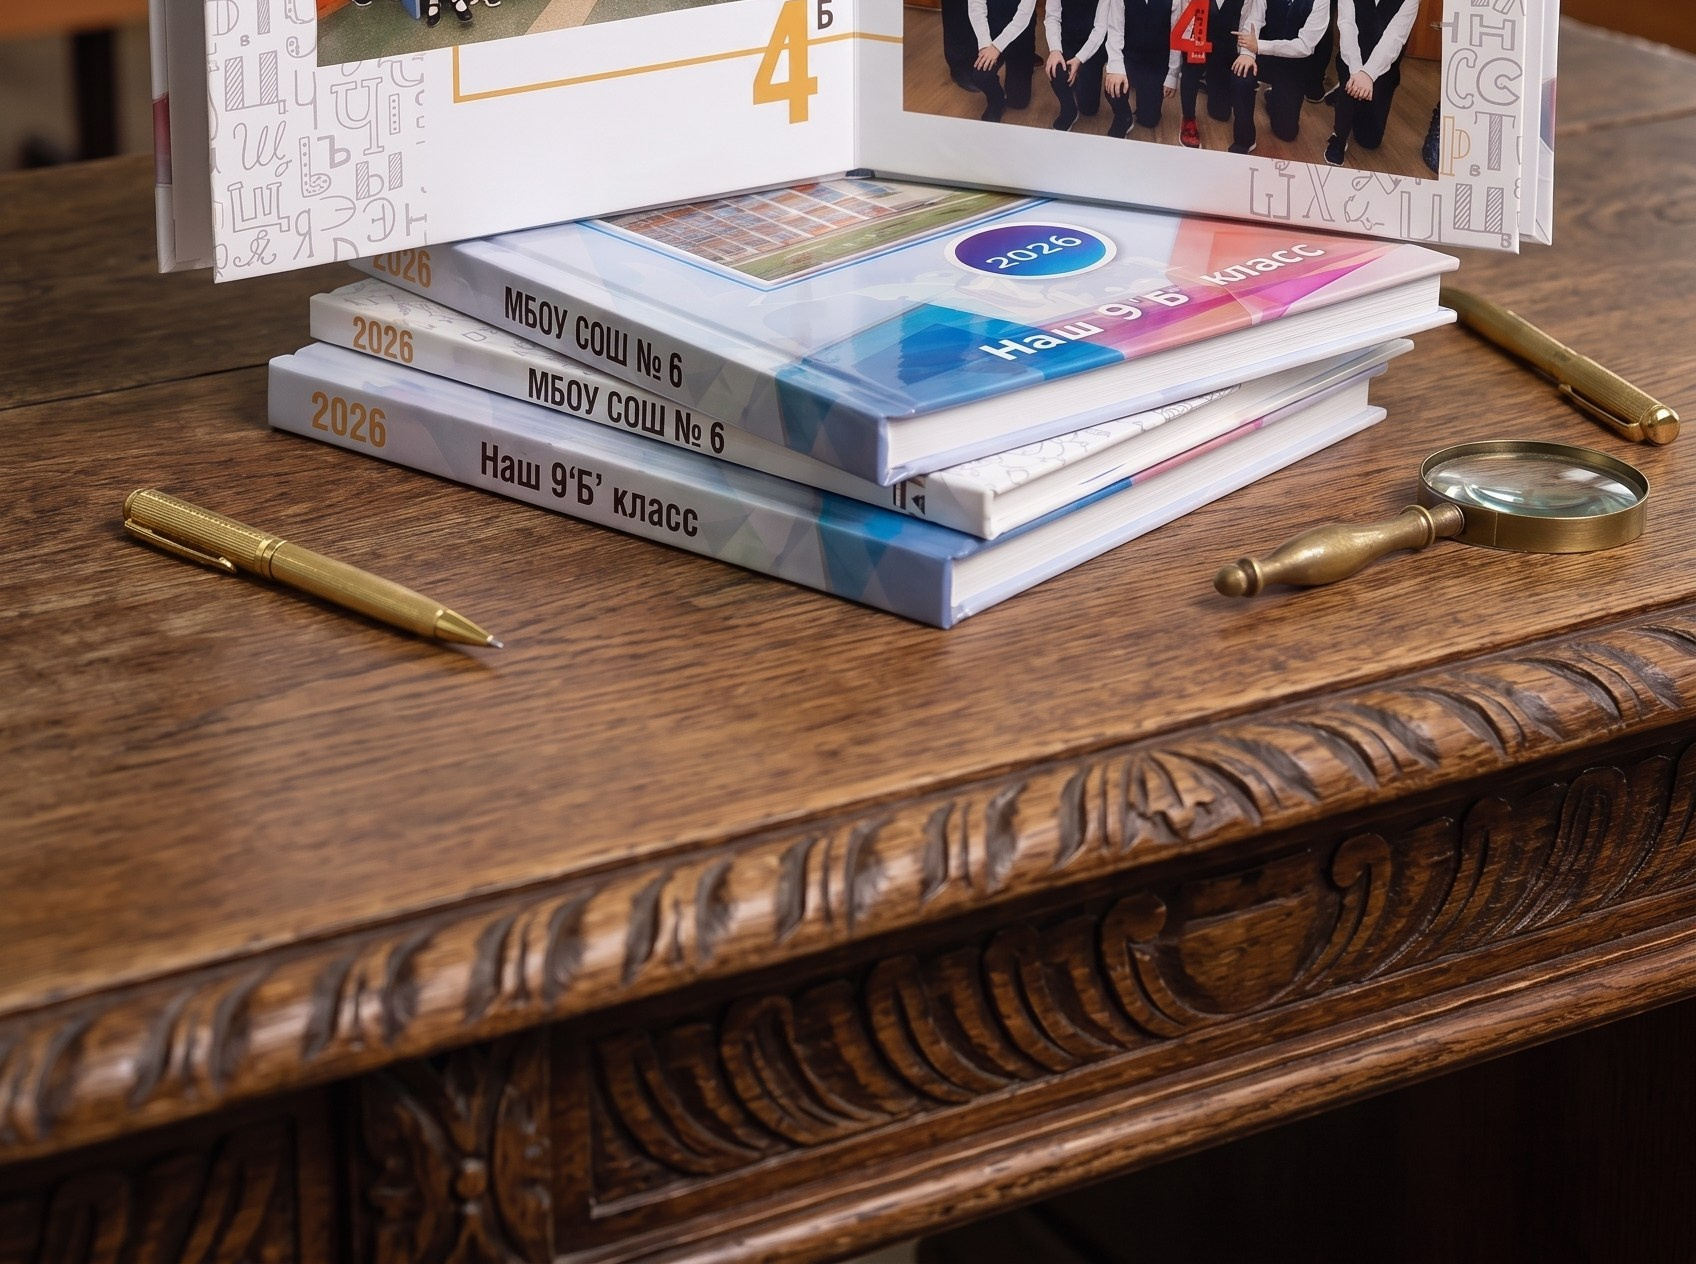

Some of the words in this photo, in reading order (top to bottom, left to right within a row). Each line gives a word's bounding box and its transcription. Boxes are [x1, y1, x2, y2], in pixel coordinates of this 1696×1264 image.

[986, 234, 1083, 270] 2026
[352, 315, 414, 364] 2026
[504, 285, 569, 340] МБОУ
[575, 315, 628, 368] СОШ
[636, 338, 662, 382] №
[668, 351, 684, 389] 6
[978, 320, 1105, 362] Наш
[1200, 243, 1326, 287] класс
[311, 391, 387, 448] 2026
[528, 367, 600, 416] МБОУ
[607, 390, 666, 437] СОШ
[674, 409, 702, 448] №
[709, 421, 726, 454] 6
[481, 441, 541, 492] Наш
[613, 486, 699, 537] класс
